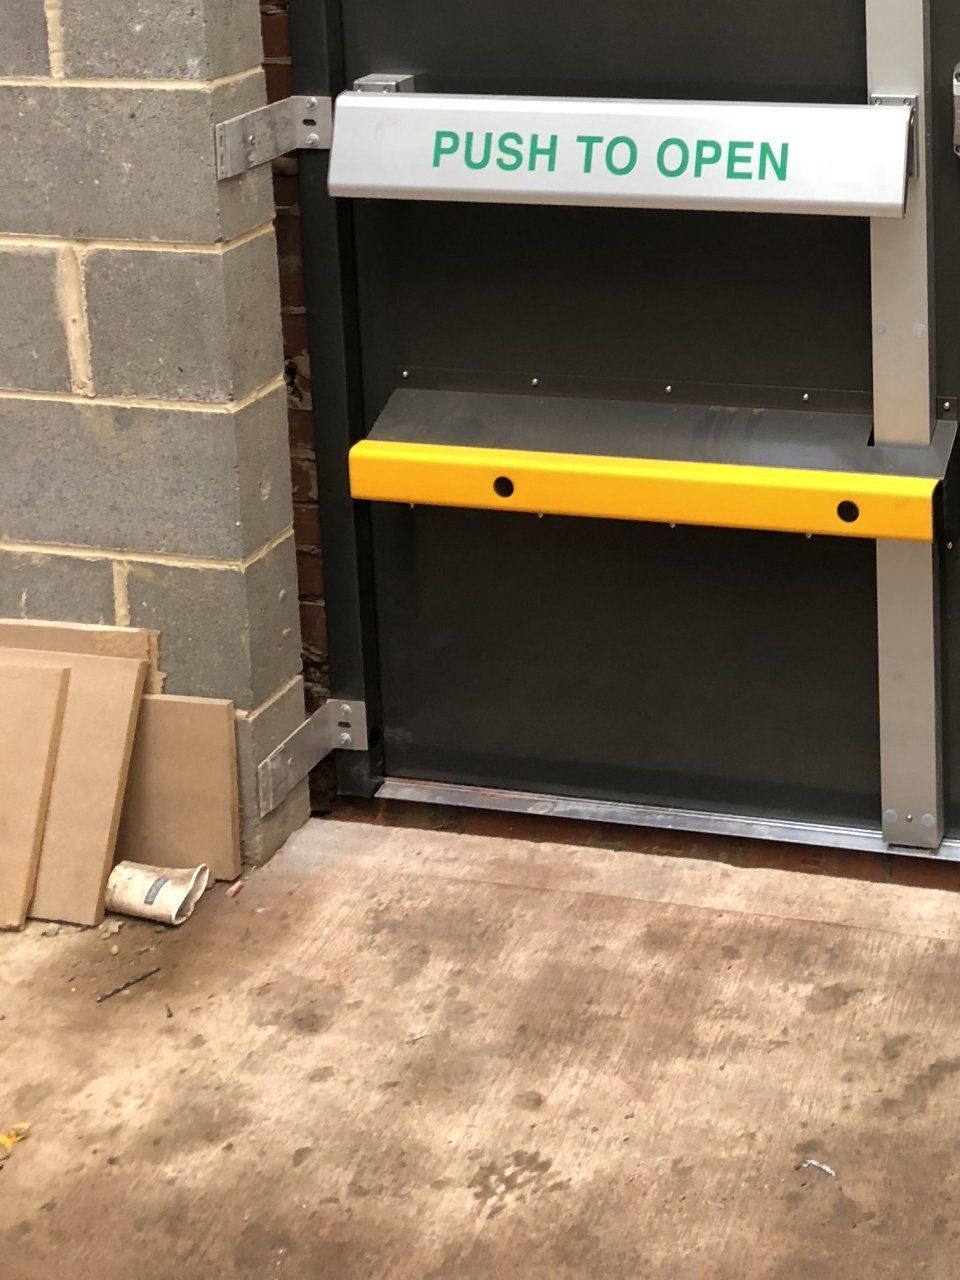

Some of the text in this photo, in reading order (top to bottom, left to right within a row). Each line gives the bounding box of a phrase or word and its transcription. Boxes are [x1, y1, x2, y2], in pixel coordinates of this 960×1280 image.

[432, 130, 790, 182] PUSH TO OPEN
